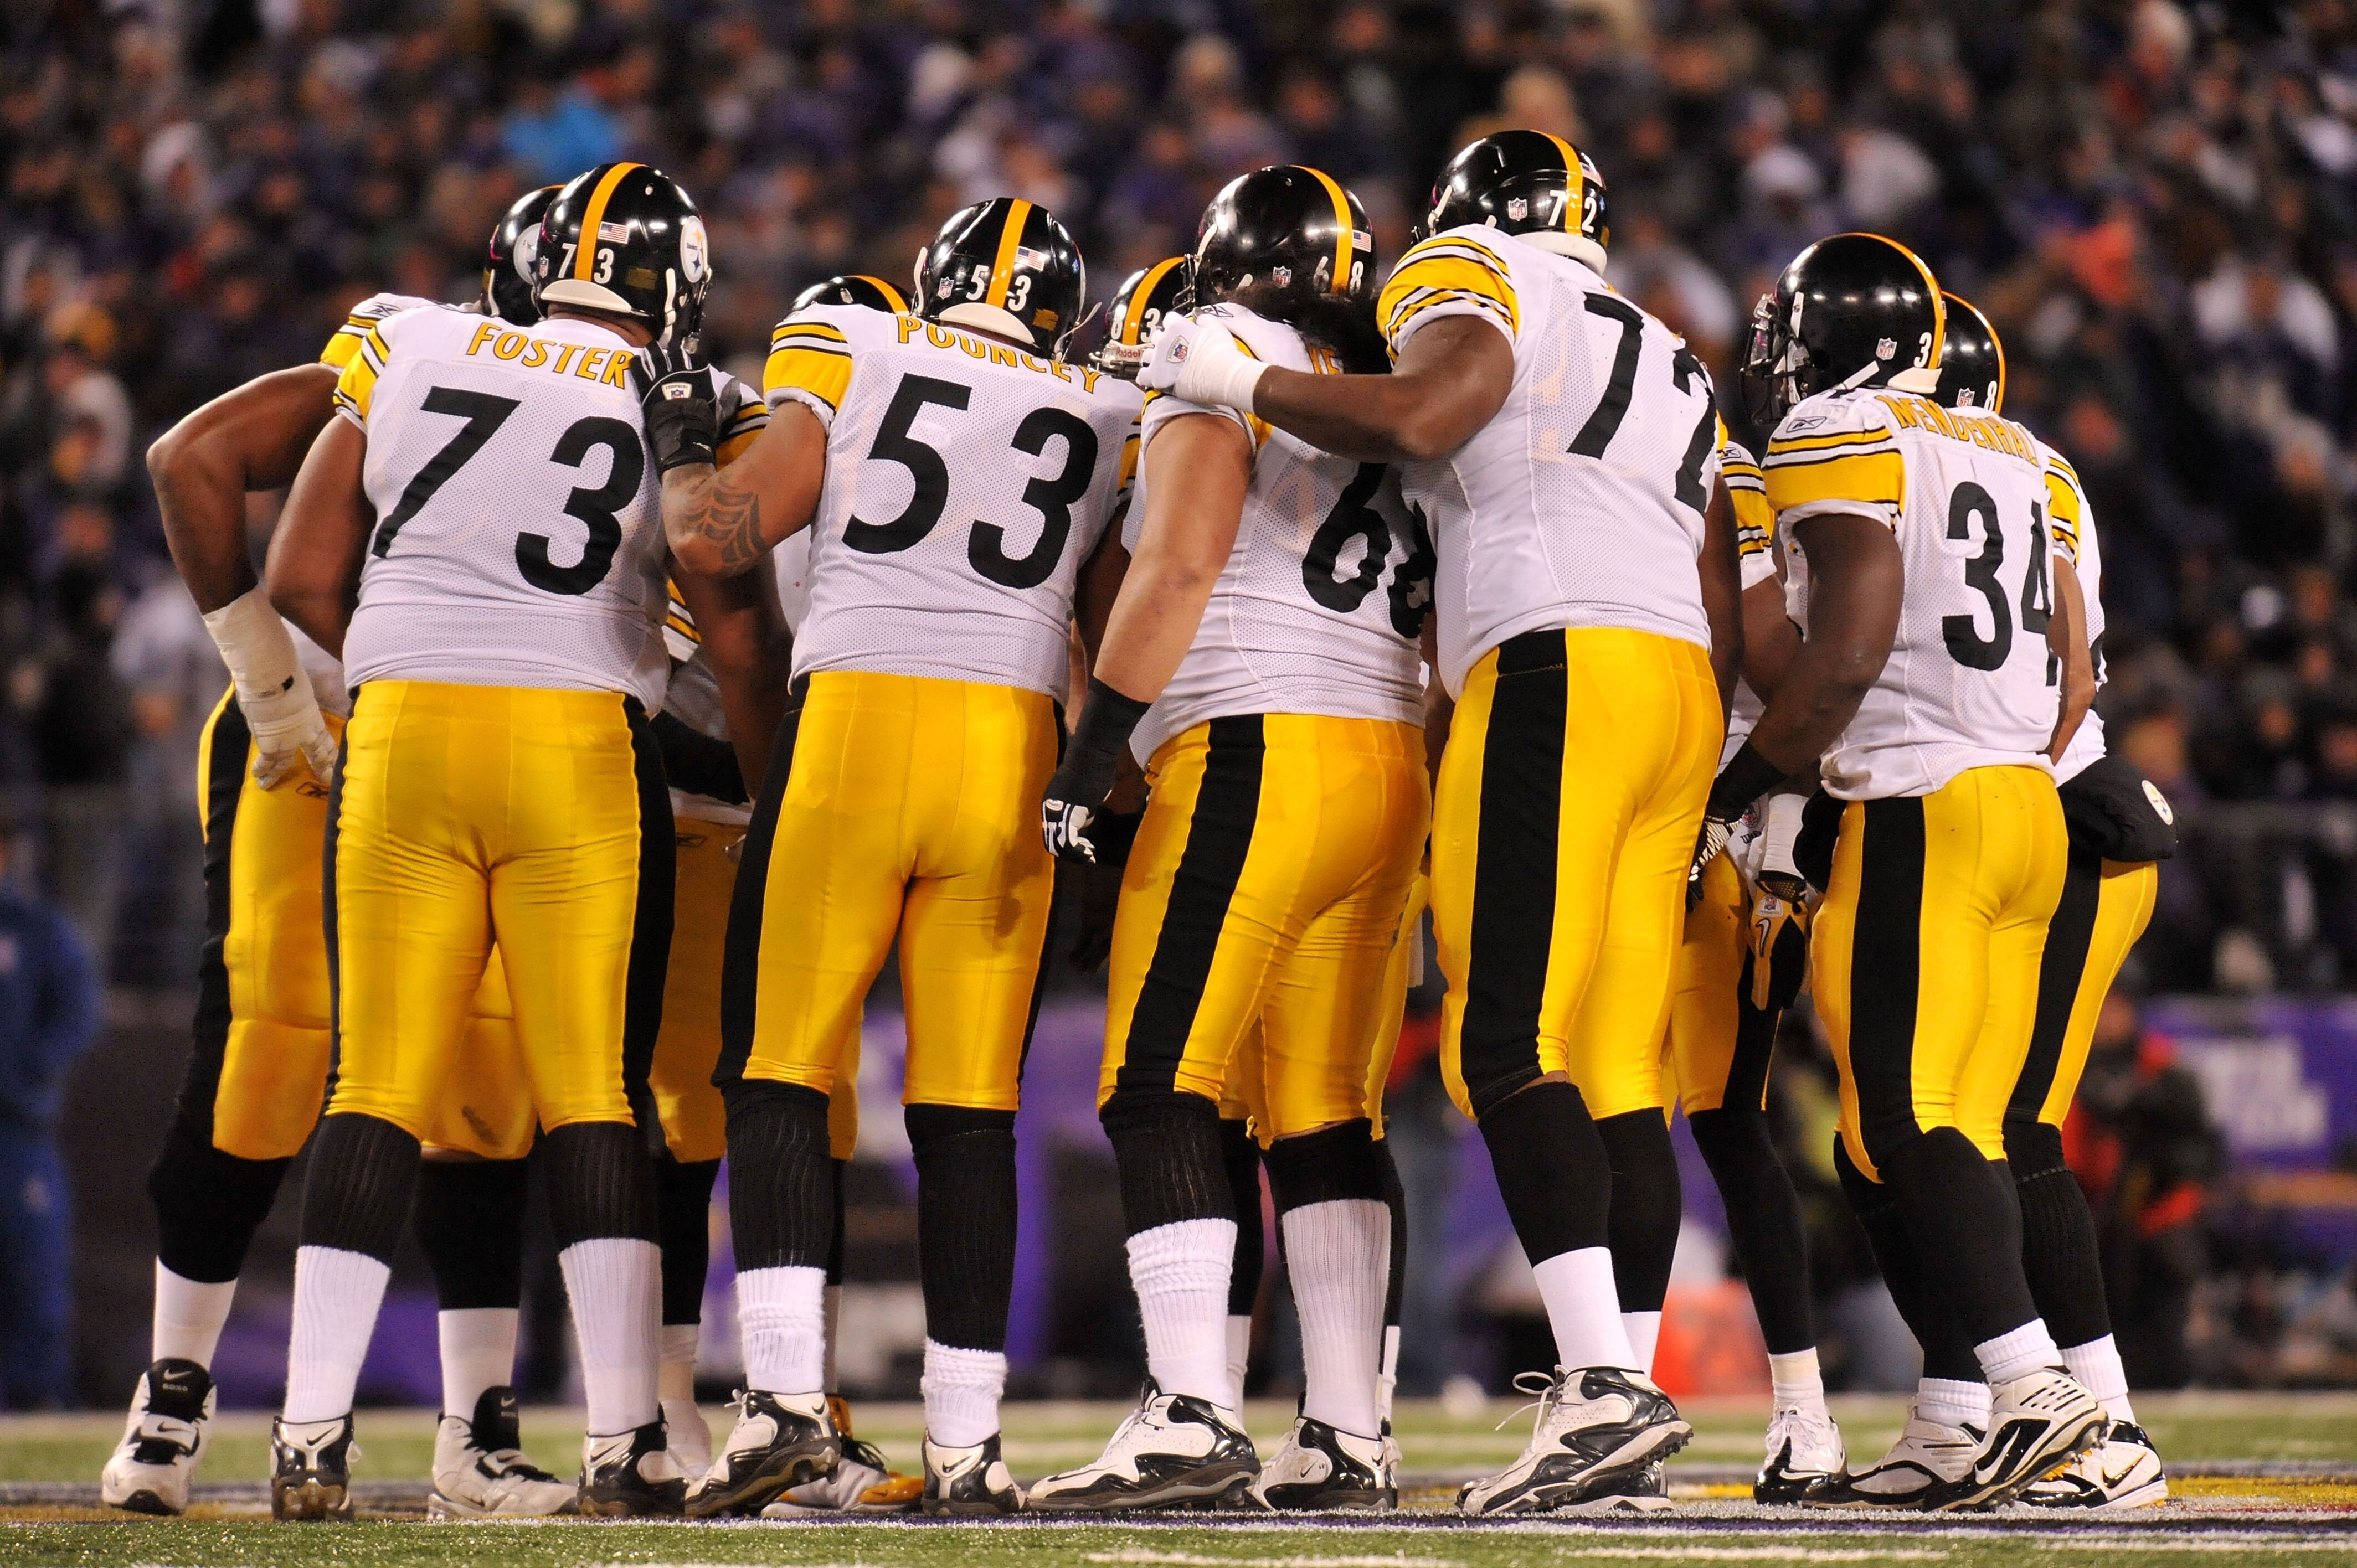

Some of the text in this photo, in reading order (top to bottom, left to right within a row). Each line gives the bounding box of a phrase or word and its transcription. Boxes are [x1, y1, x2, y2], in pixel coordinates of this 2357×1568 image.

[1548, 190, 1597, 233] 72
[558, 243, 614, 284] 73
[966, 265, 1031, 311] 53
[1313, 256, 1364, 295] 68
[466, 322, 635, 390] FOSTER
[897, 316, 1102, 394] POUNCEY
[1111, 305, 1160, 343] 83
[1567, 291, 1716, 519] 72
[372, 386, 644, 595] 73
[842, 373, 1098, 590] 53
[1942, 481, 2059, 687] 34
